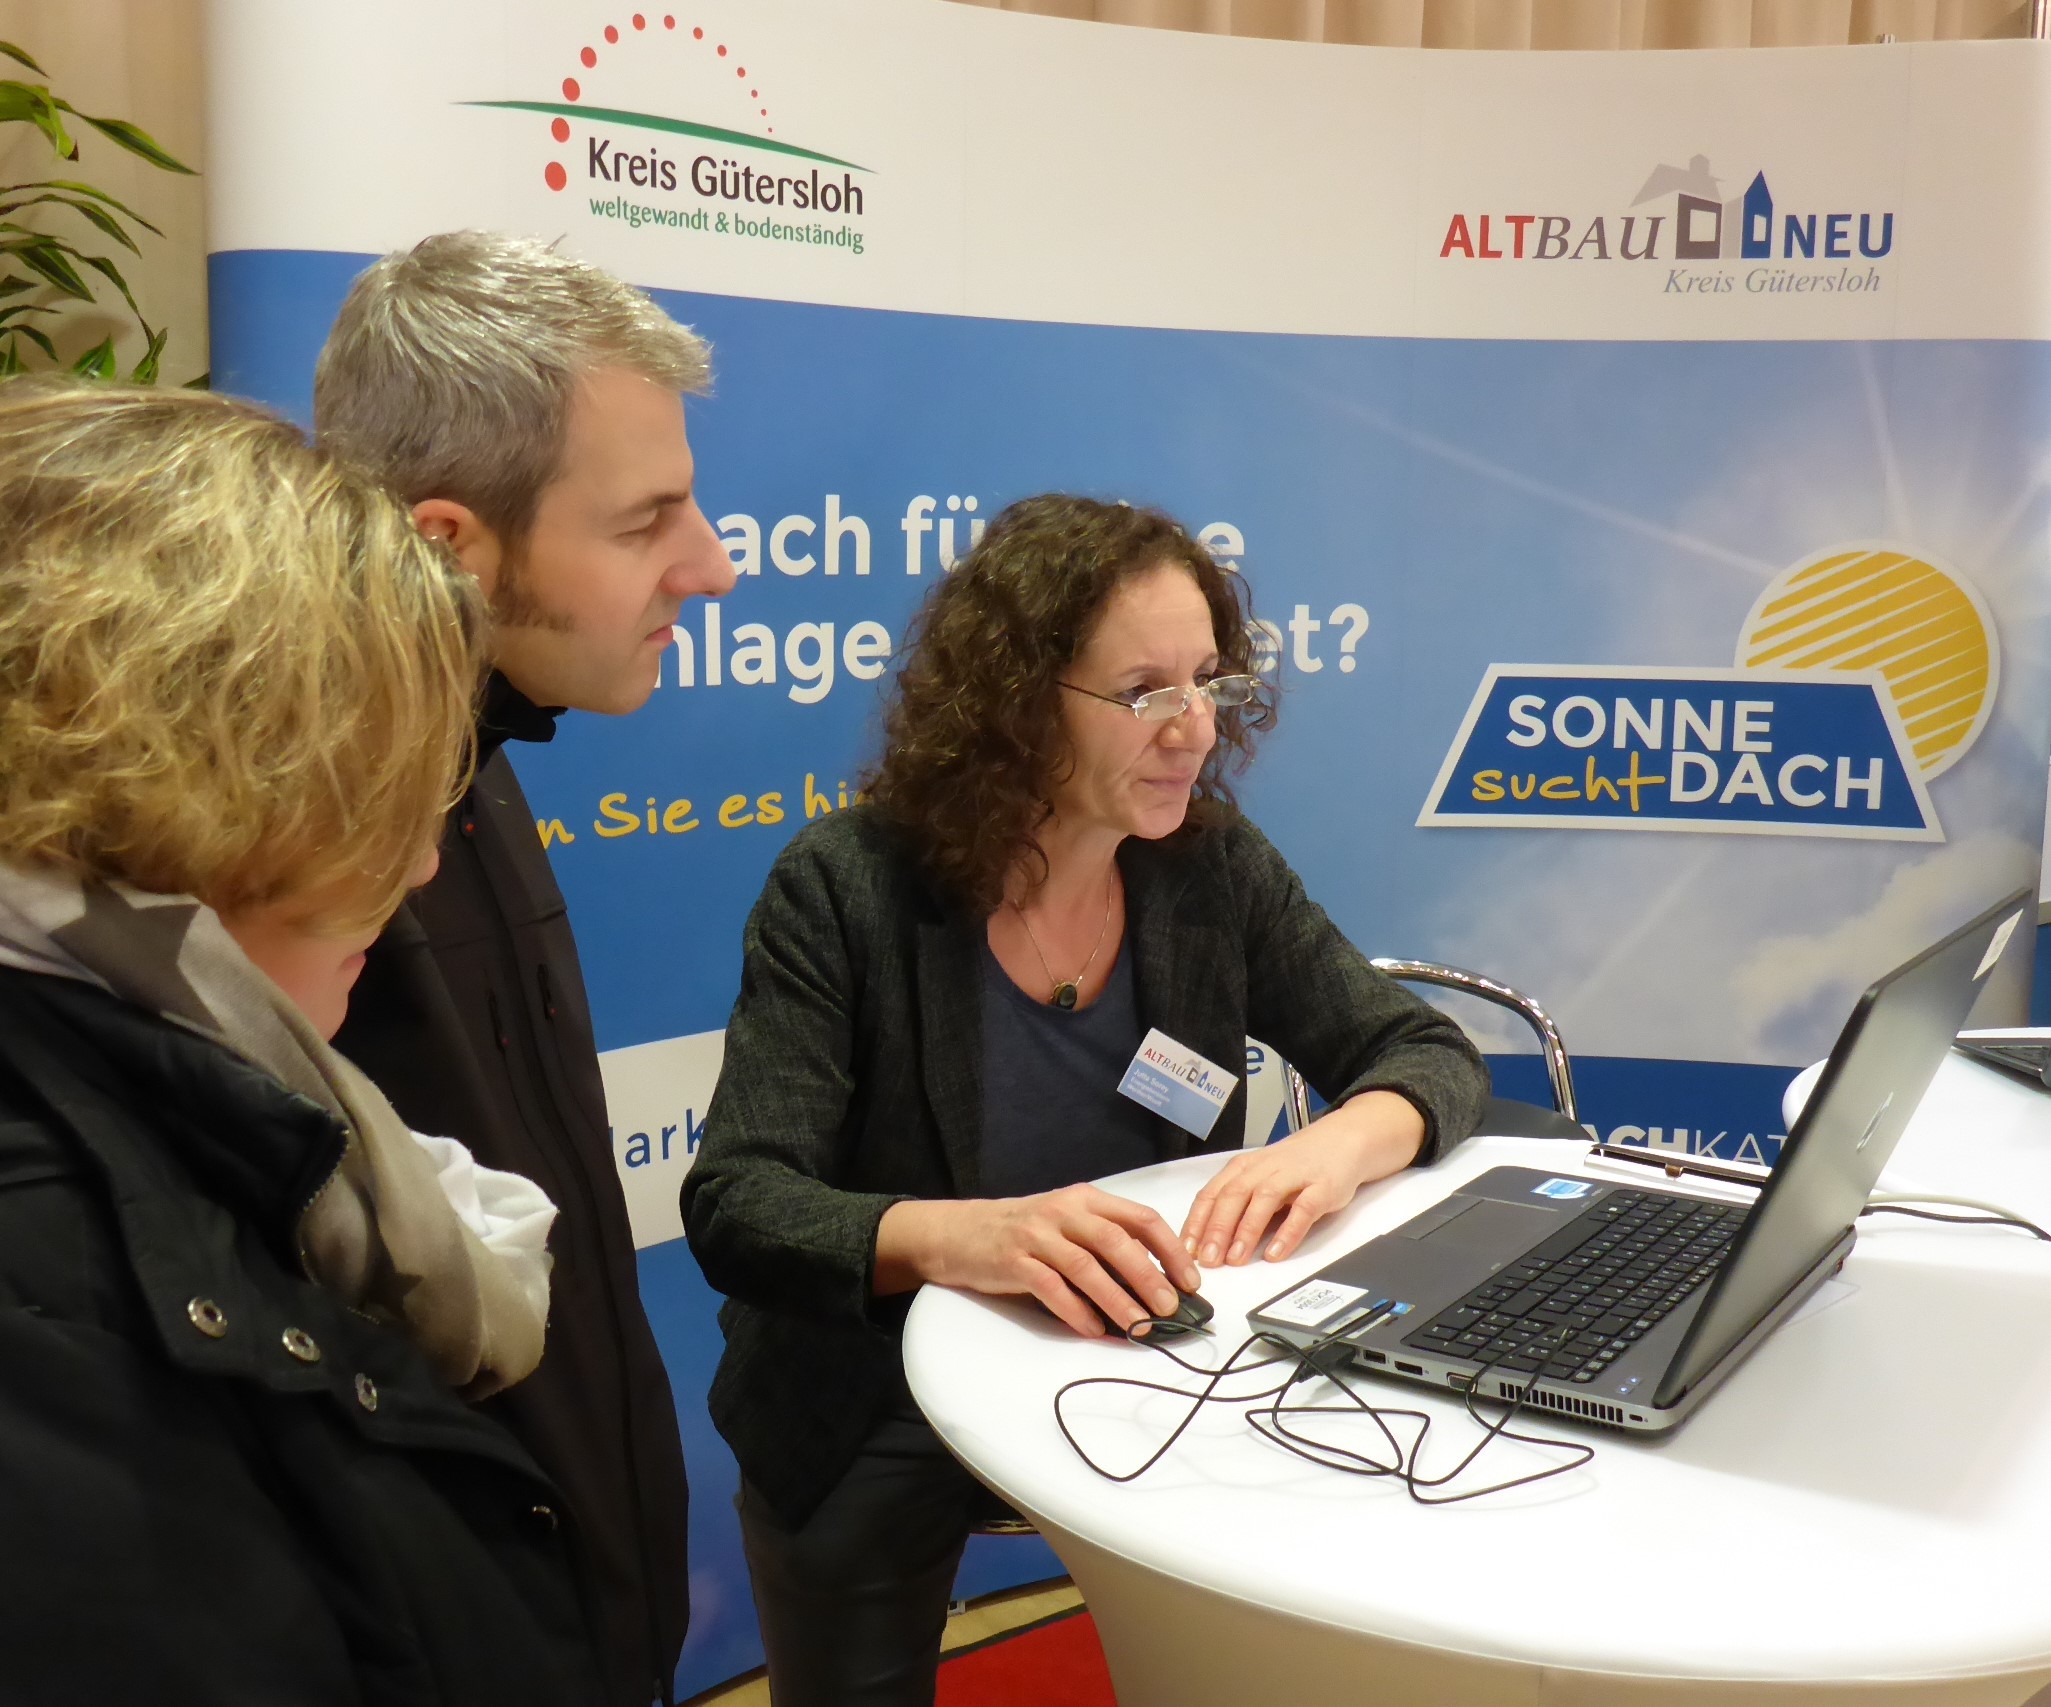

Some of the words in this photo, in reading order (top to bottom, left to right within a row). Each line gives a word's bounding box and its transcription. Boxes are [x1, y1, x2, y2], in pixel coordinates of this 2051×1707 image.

[589, 137, 677, 191] Kreis
[691, 156, 864, 215] Gütersloh
[589, 197, 709, 229] weltgewandt
[714, 211, 730, 234] &
[734, 213, 864, 254] bodenständig
[1440, 214, 1665, 259] ALTBAU
[1784, 212, 1893, 258] NEU
[1663, 269, 1735, 293] Kreis
[1745, 267, 1881, 293] Gütersloh
[1506, 695, 1774, 753] SONNE
[1471, 750, 1665, 812] sucht
[1669, 751, 1883, 810] DACH
[593, 792, 699, 838] Sie
[718, 791, 785, 829] es
[609, 1108, 708, 1169] ark
